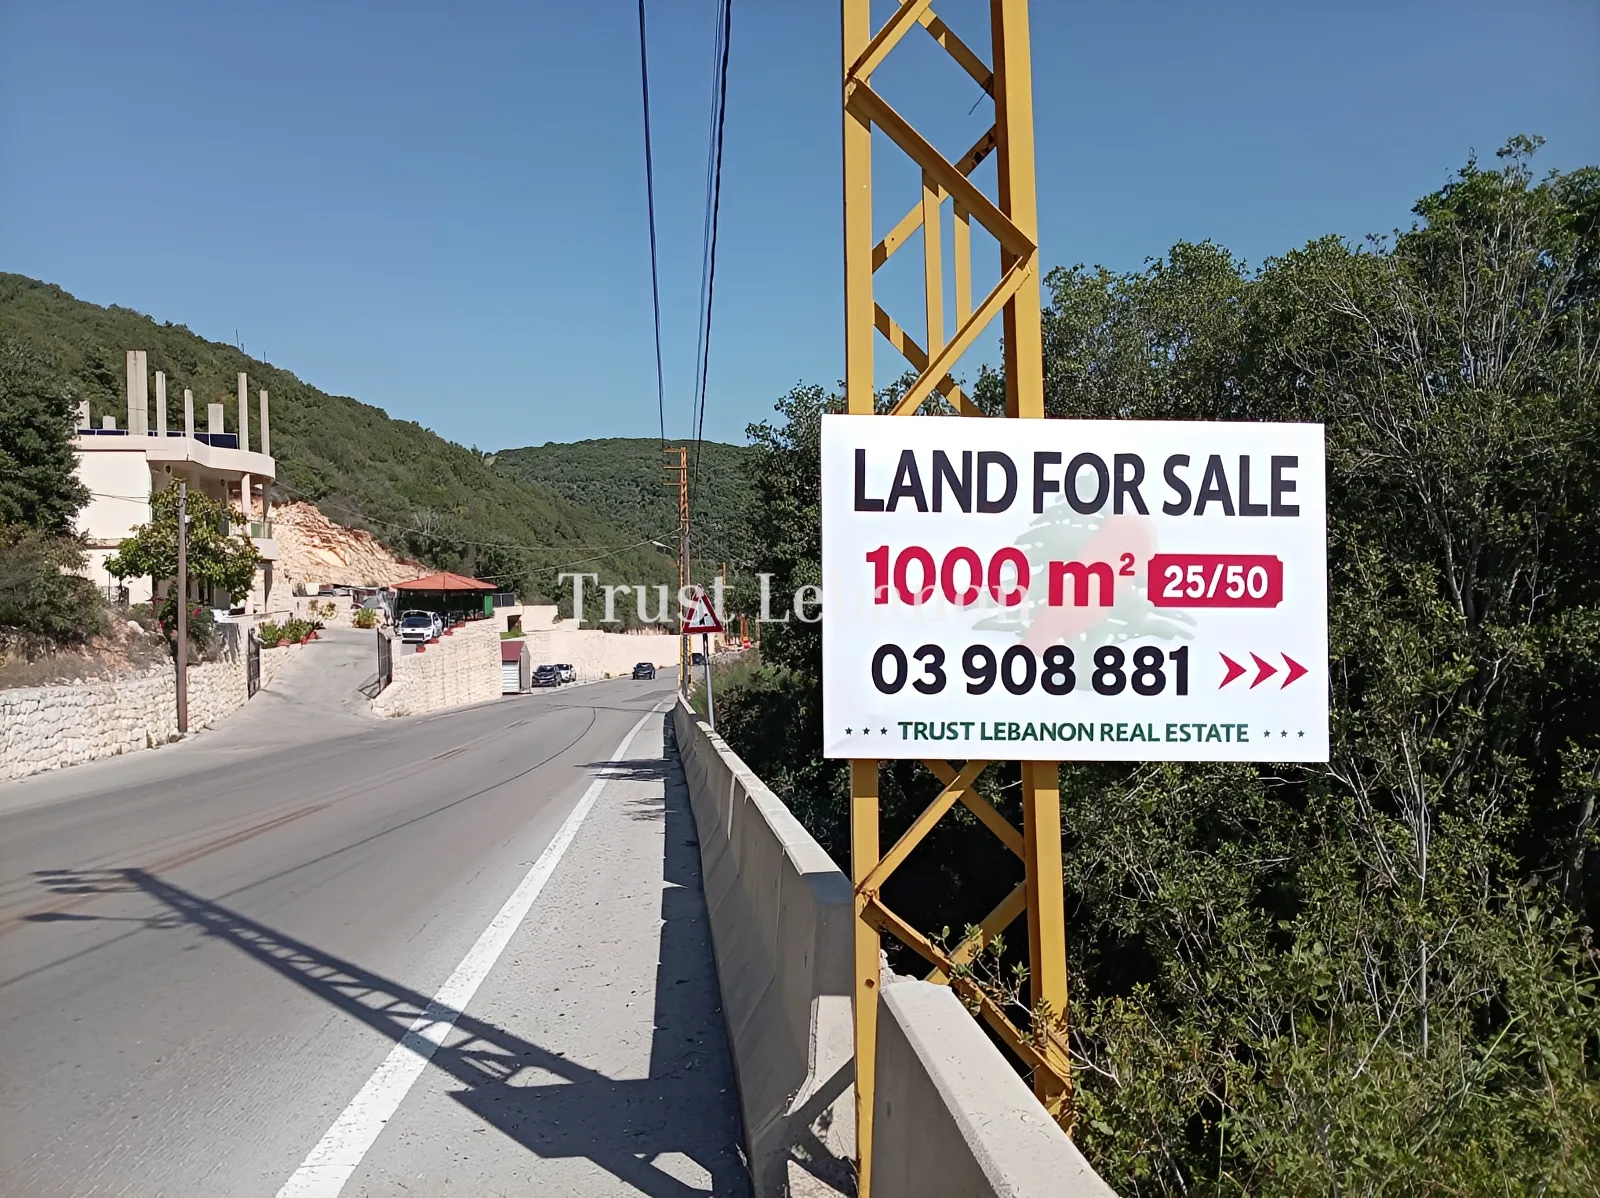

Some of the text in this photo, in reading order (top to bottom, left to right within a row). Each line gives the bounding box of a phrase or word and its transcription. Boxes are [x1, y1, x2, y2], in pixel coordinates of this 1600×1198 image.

[853, 448, 1300, 517] LAND FOR SALE
[865, 545, 1031, 607] 1000
[1162, 564, 1269, 599] 25/50
[871, 643, 1189, 697] 03 908 881
[897, 721, 1250, 744] TRUST LEBANON REAL ESTATE
